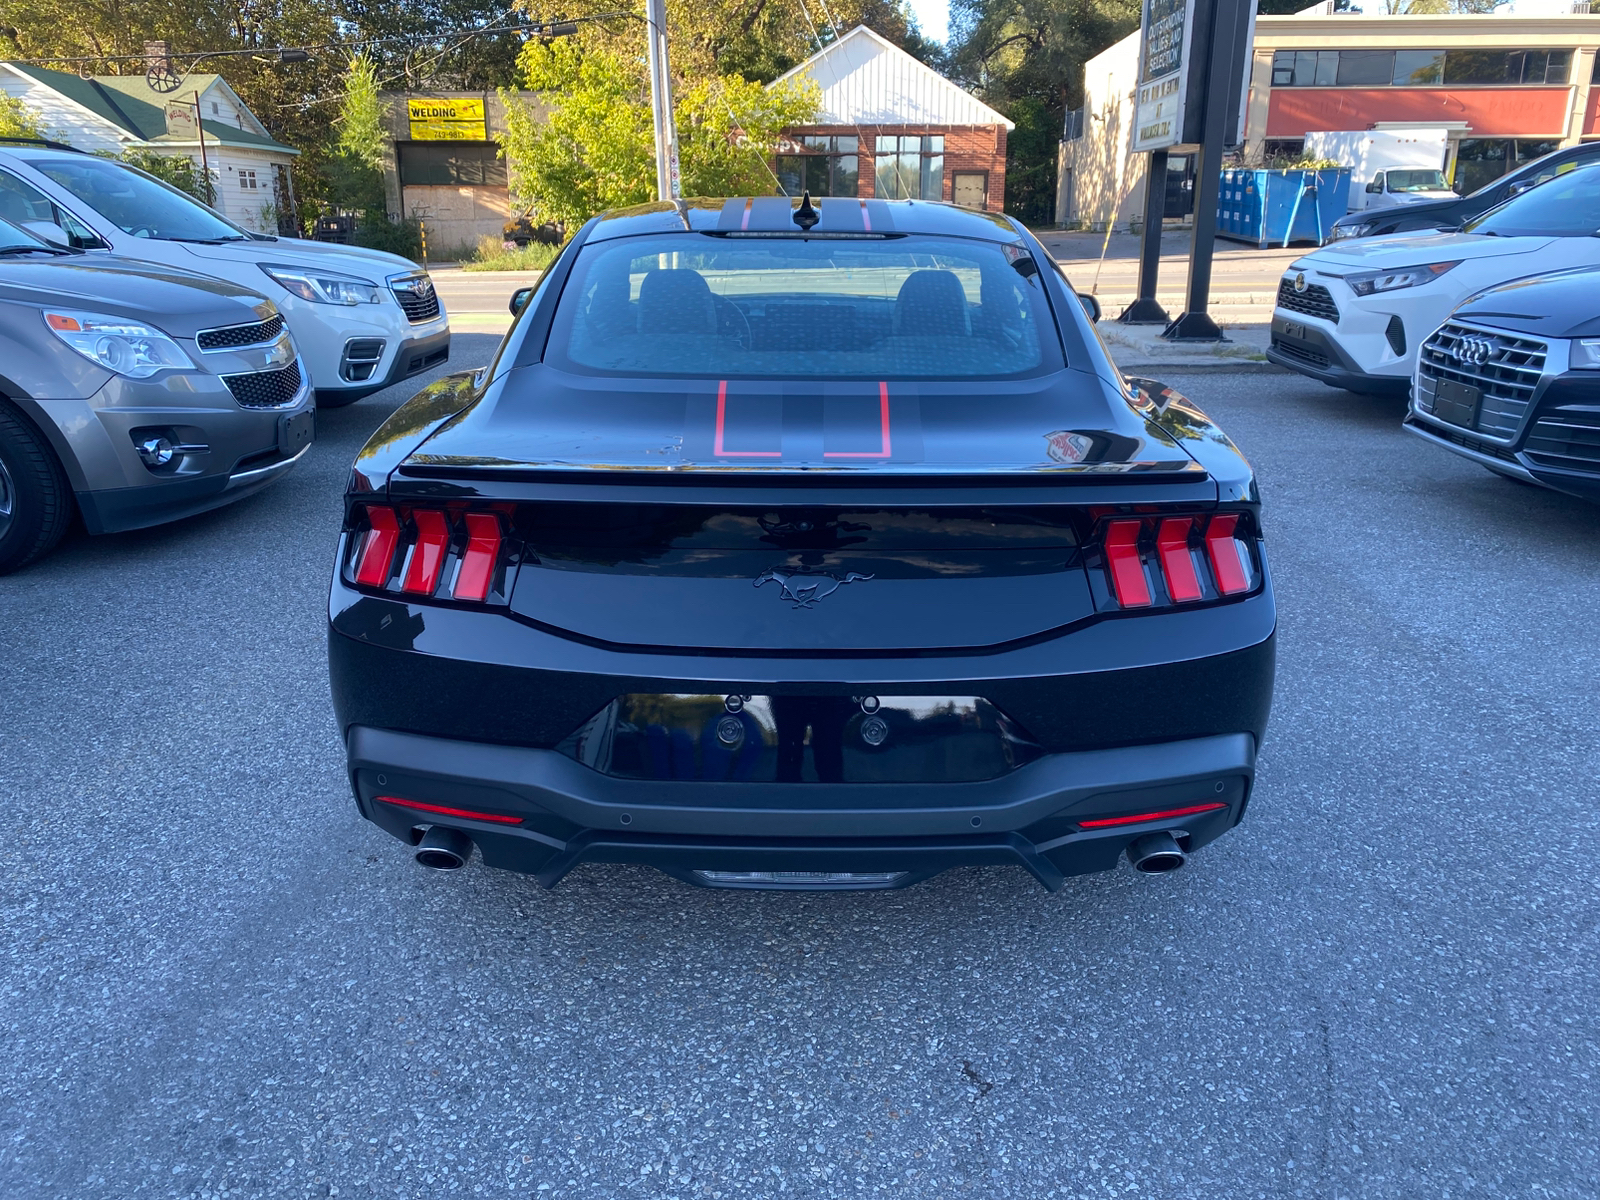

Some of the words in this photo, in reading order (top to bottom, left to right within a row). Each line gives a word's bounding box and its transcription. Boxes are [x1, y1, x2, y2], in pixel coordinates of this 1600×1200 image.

[1148, 7, 1185, 40] OUTSTANDING
[1149, 47, 1180, 73] SELECTION
[168, 110, 192, 123] WELDING
[411, 108, 456, 117] WELDING
